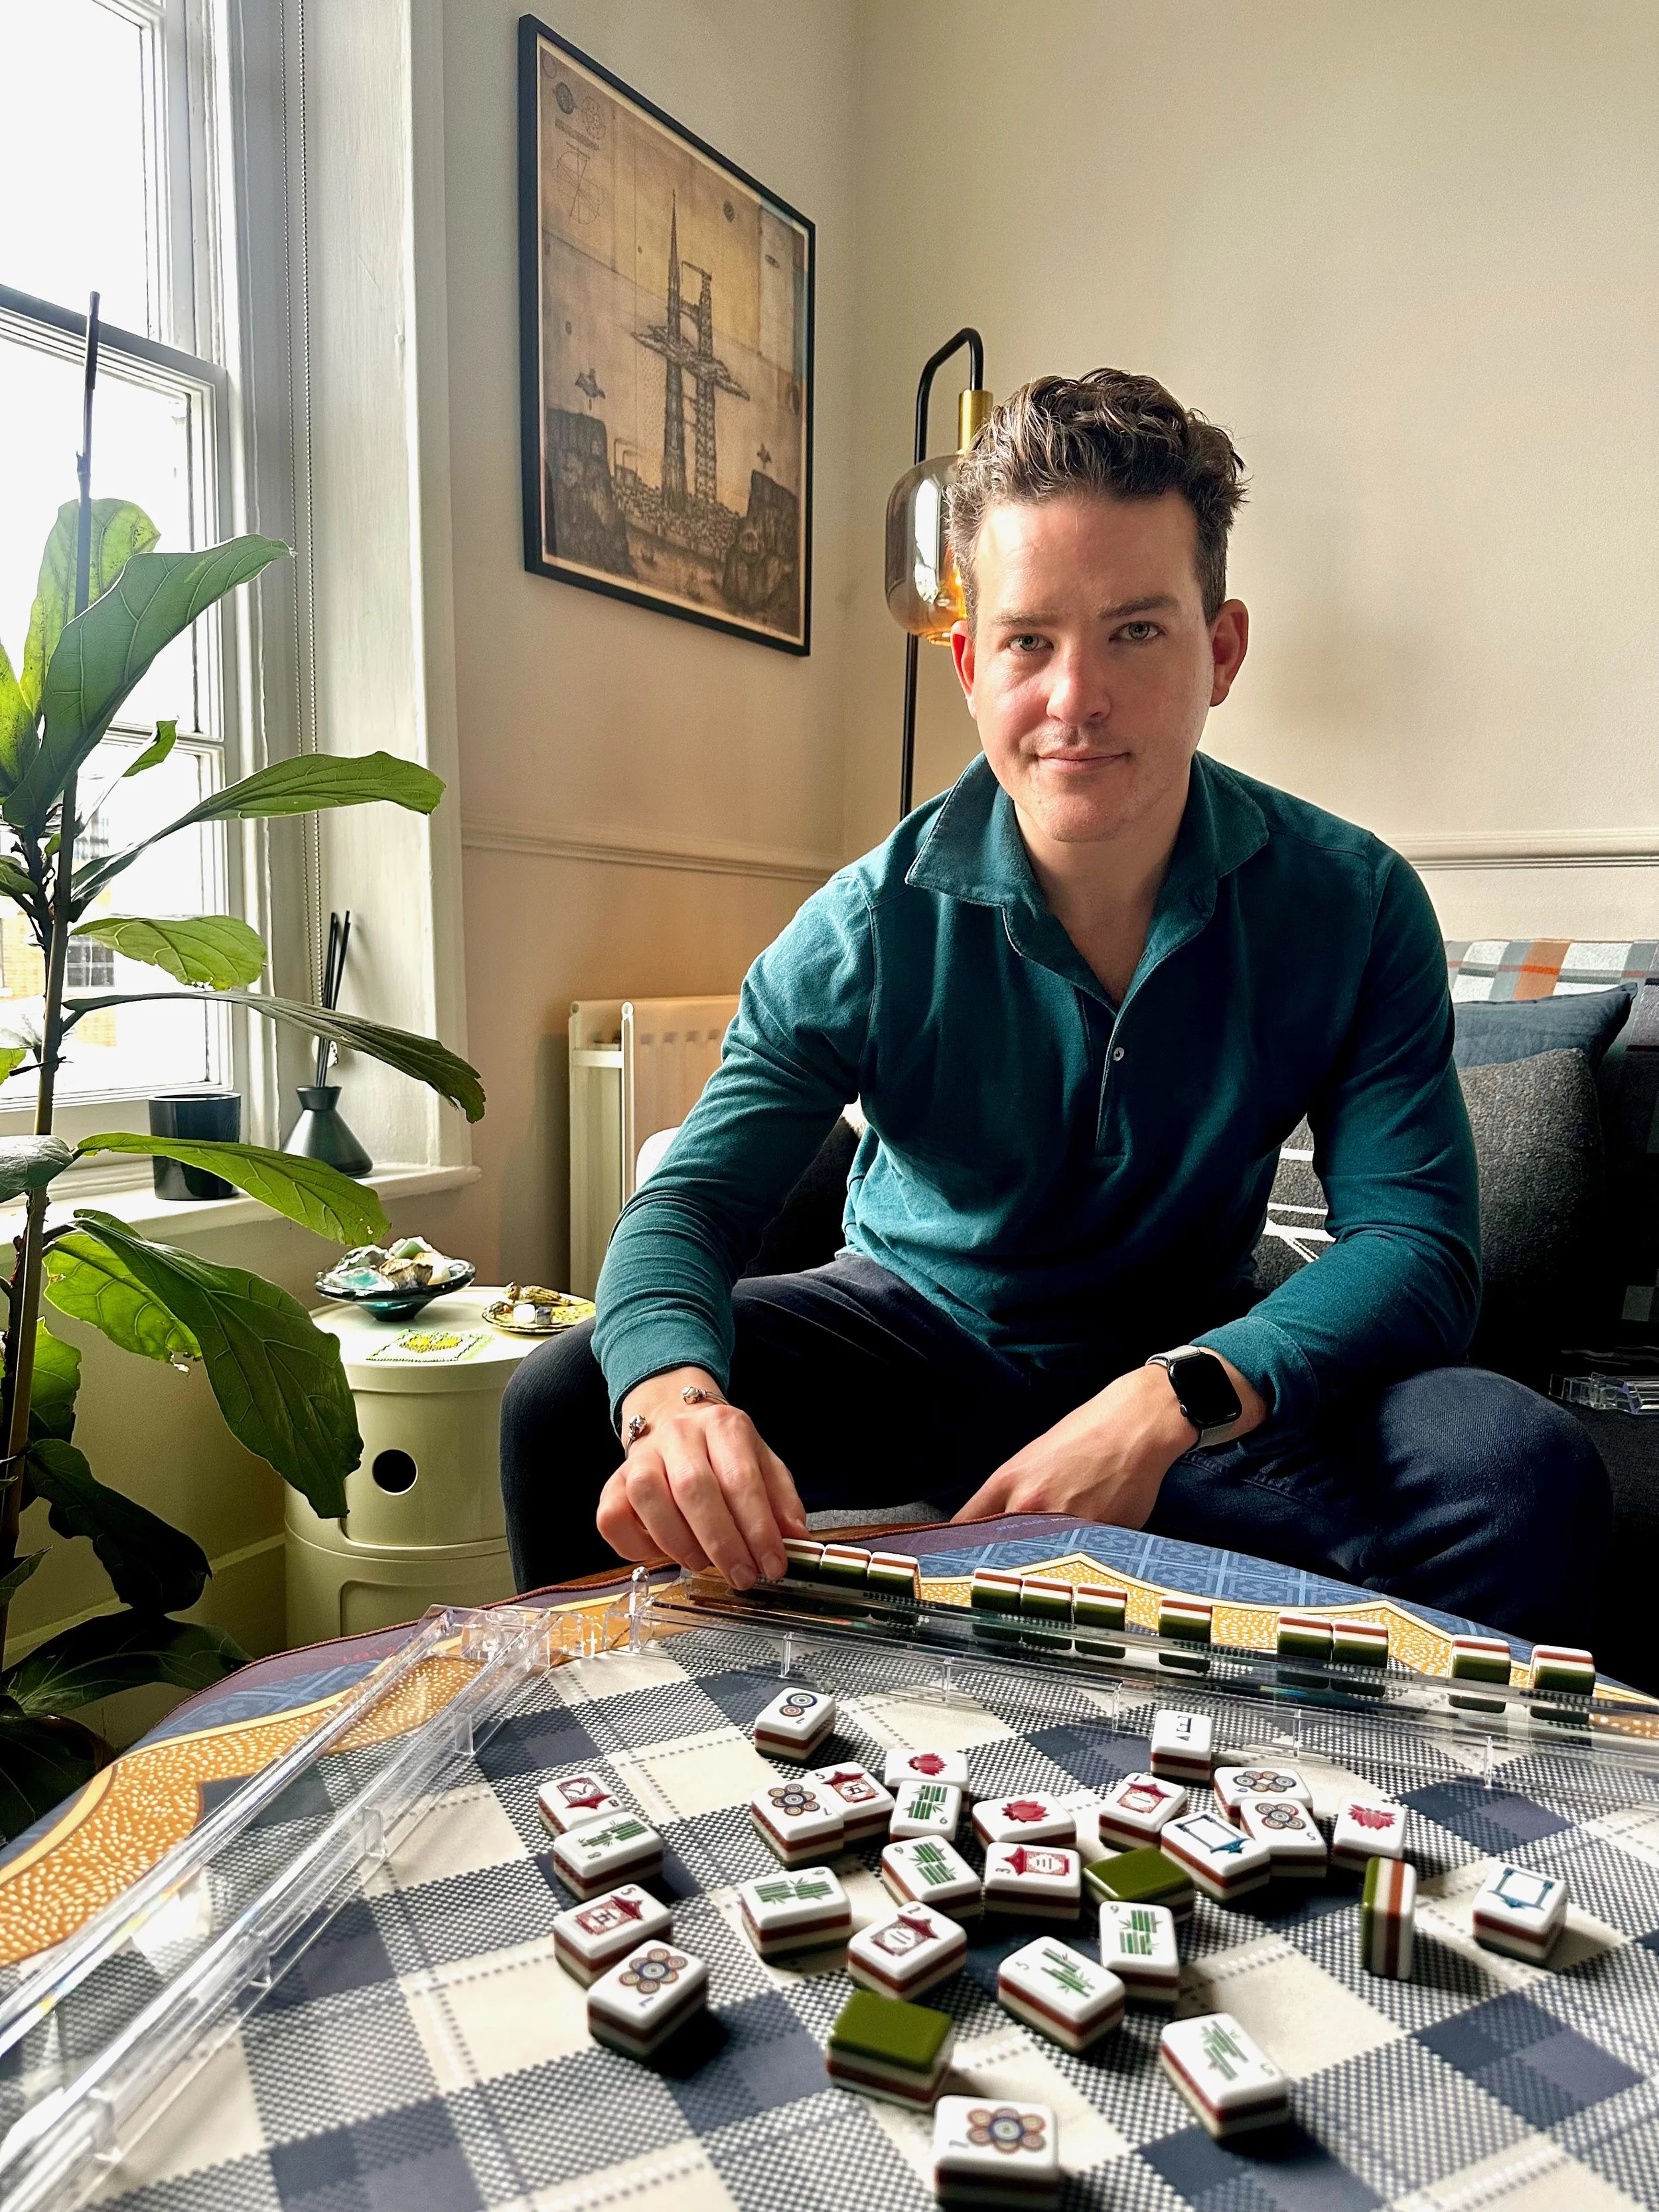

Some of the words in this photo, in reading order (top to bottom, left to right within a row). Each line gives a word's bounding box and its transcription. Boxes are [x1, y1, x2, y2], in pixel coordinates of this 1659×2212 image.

[1176, 1716, 1192, 1733] E
[843, 1783, 867, 1795] 五
[824, 1807, 832, 1816] 7
[1306, 1832, 1317, 1841] 5
[620, 1887, 636, 1895] 5
[592, 1909, 617, 1925] 五
